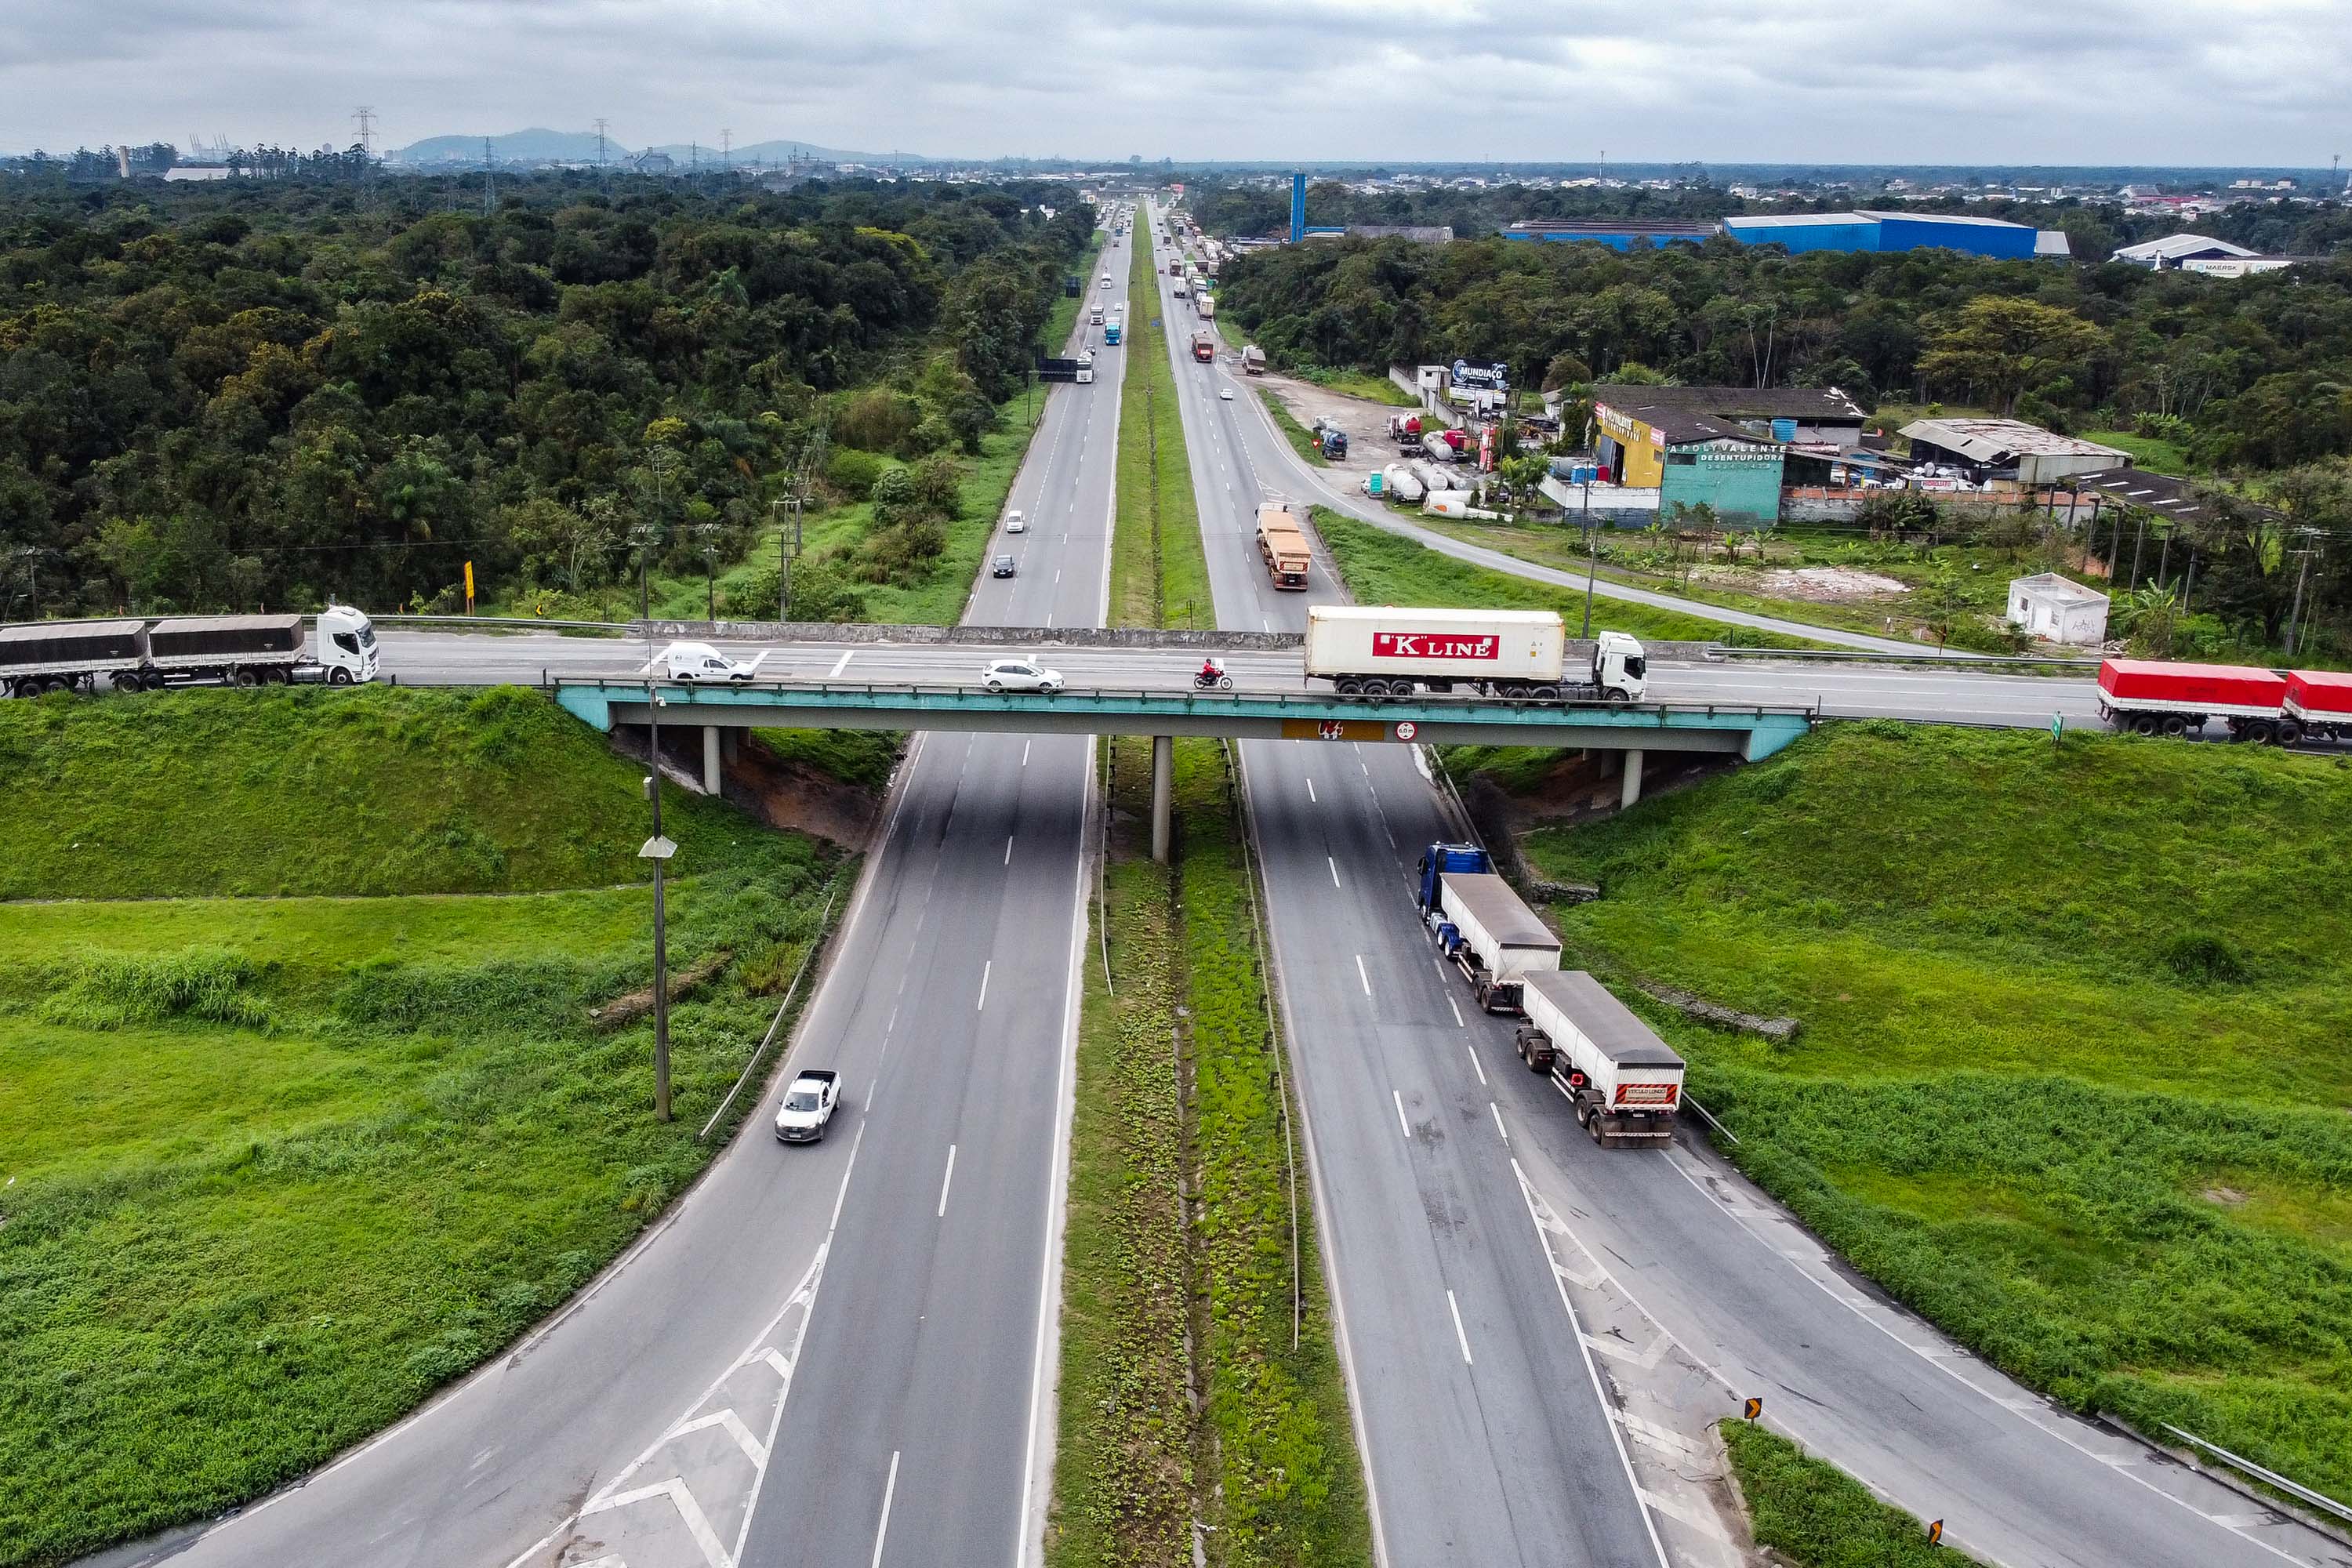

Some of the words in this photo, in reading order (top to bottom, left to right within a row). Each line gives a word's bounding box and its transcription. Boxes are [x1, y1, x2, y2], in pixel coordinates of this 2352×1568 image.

[1461, 367, 1502, 379] MUNDIAÇO
[1682, 445, 1787, 453] POLYVALENTE
[1428, 642, 1490, 656] LINE
